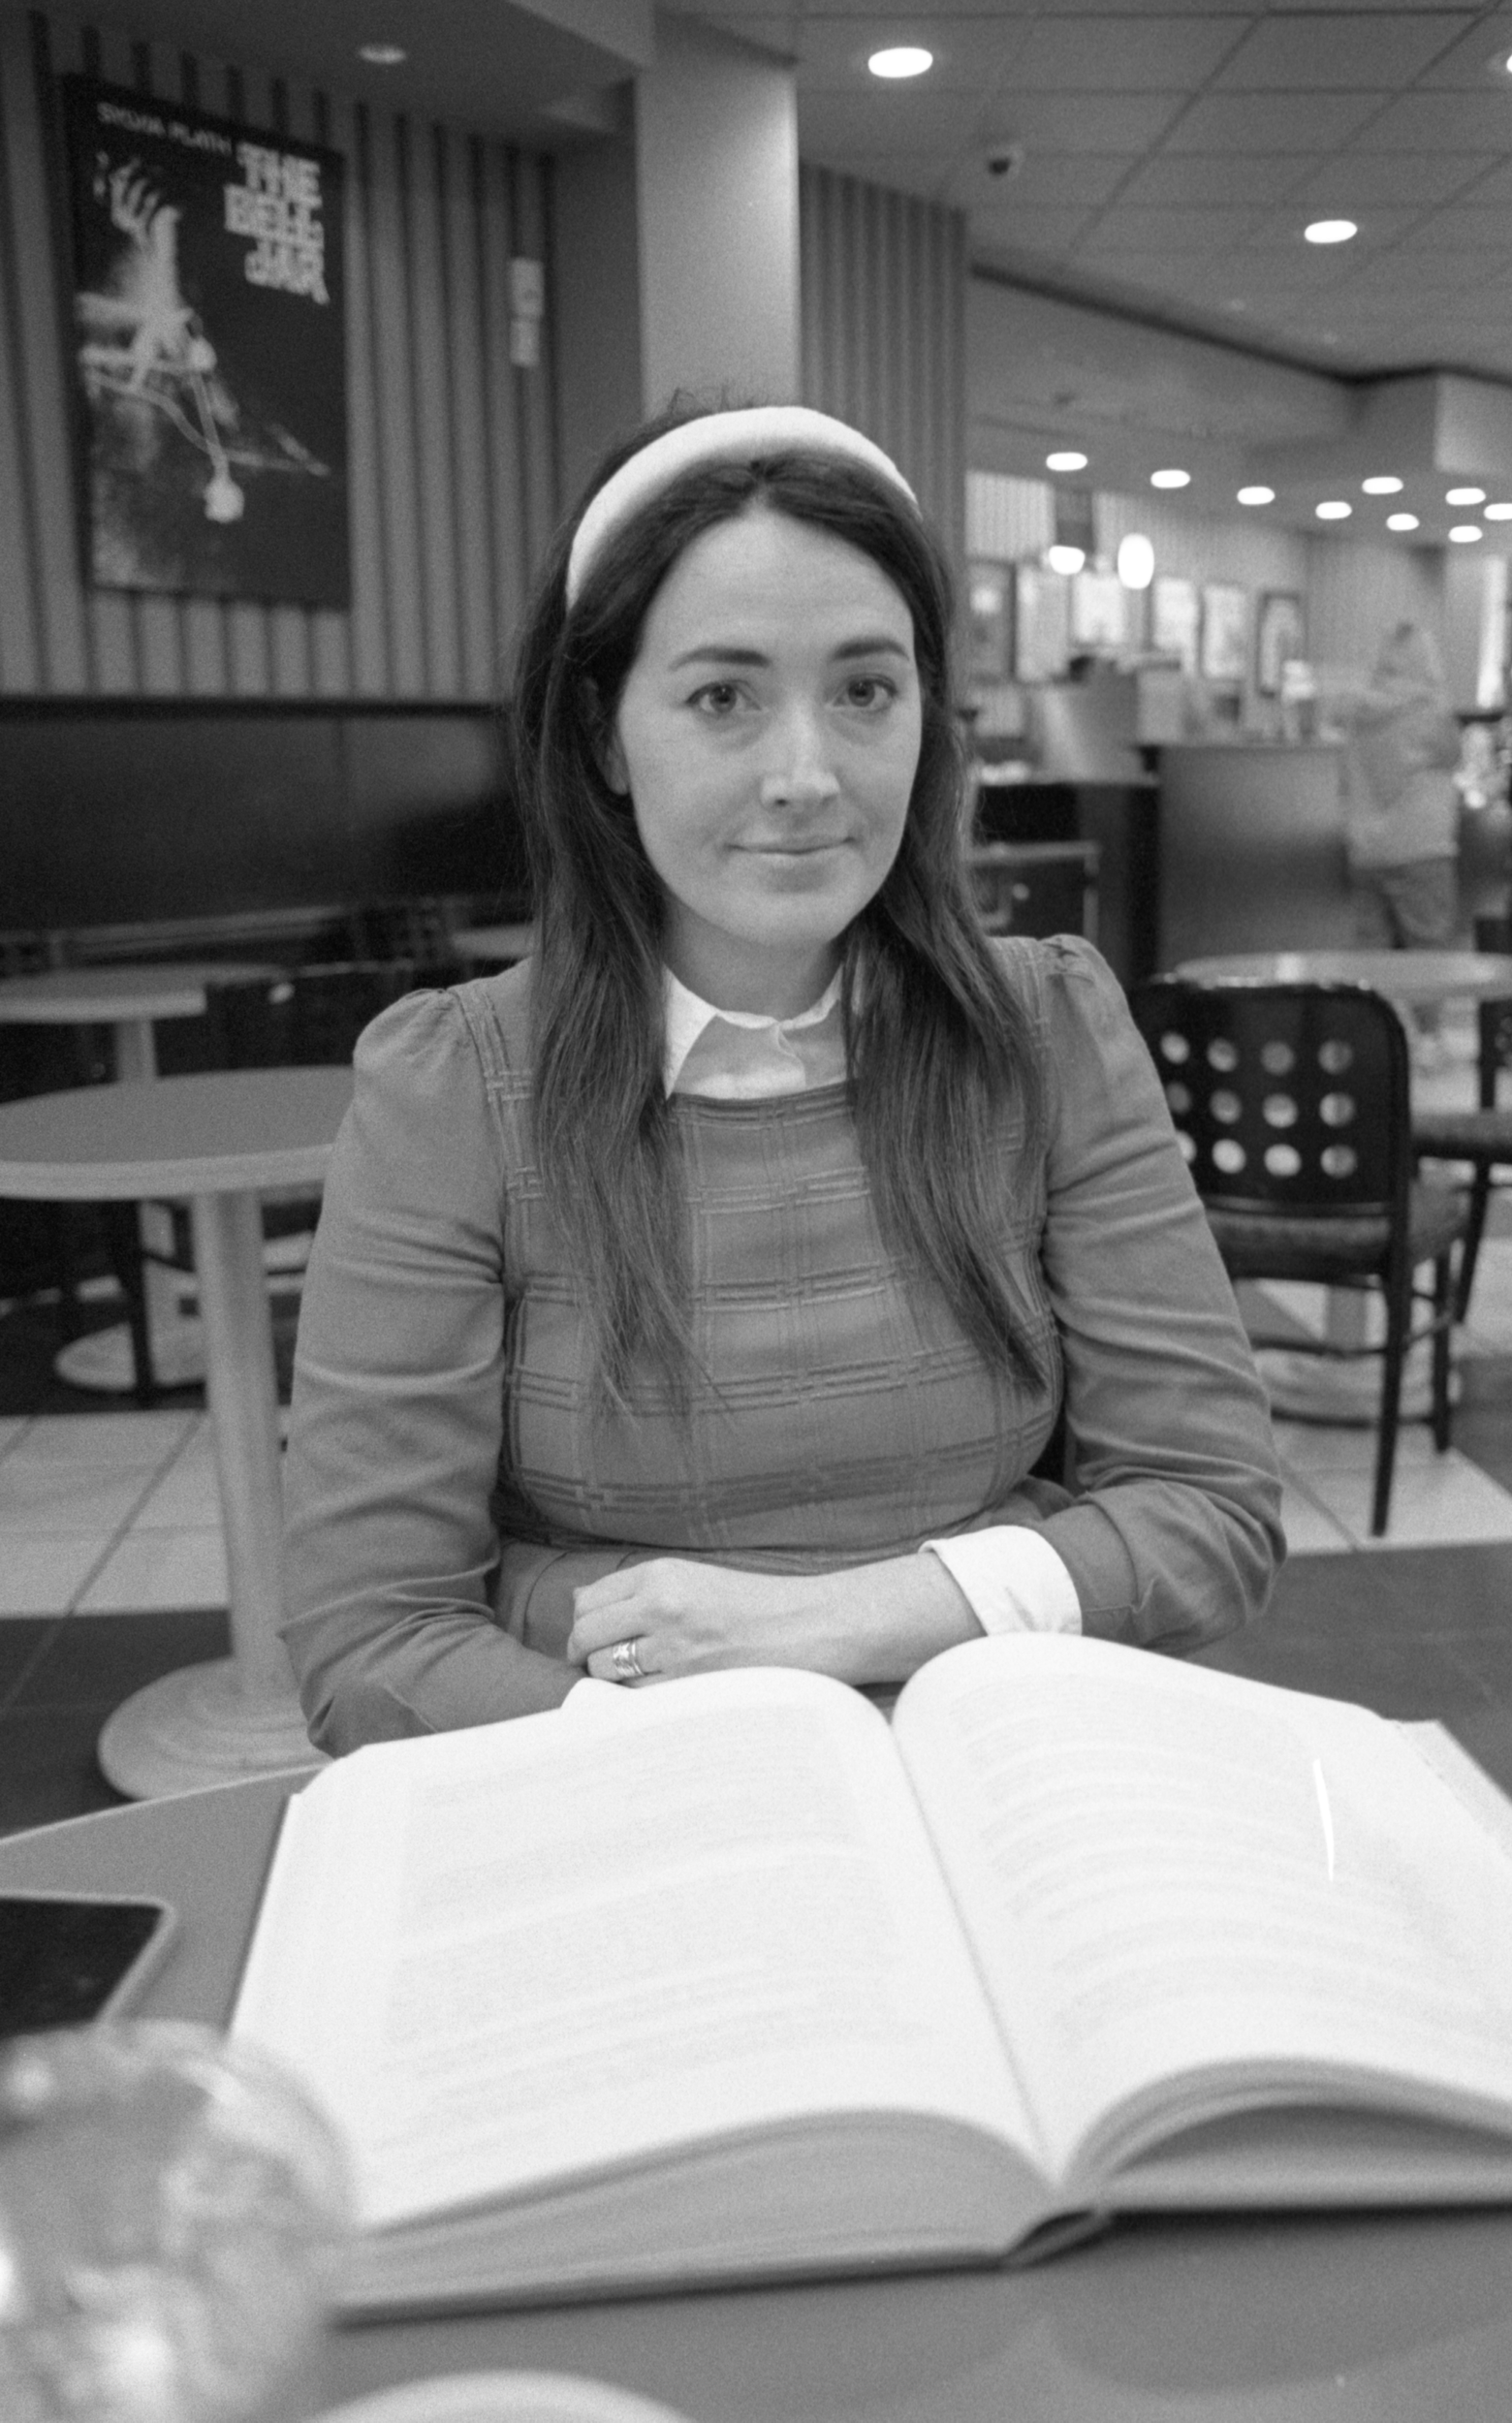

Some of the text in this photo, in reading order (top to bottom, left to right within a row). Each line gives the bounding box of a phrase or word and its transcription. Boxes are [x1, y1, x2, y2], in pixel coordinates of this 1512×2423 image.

[98, 101, 232, 156] SYLVIA PLATH
[236, 142, 323, 210] THE
[223, 182, 325, 250] BELL
[244, 239, 331, 305] JAR
